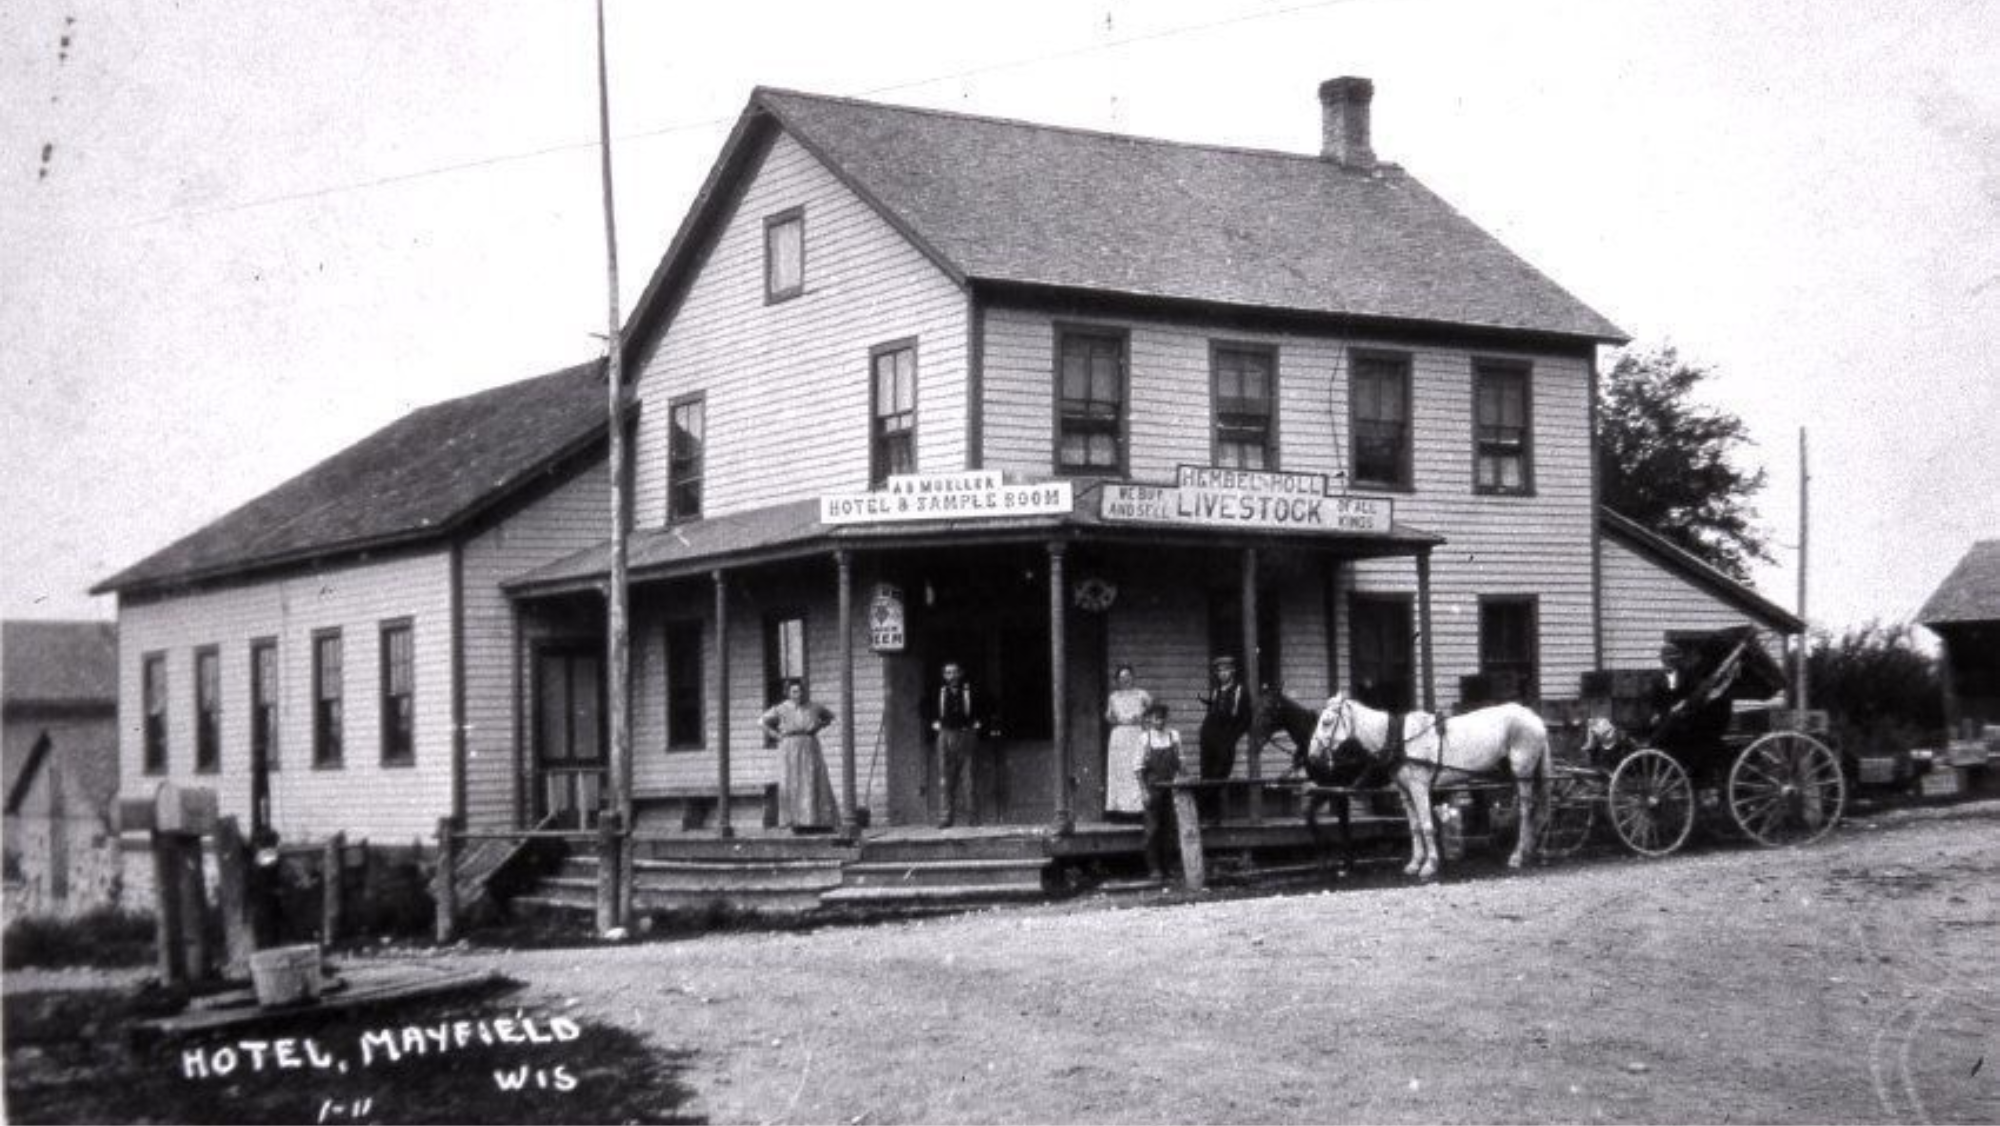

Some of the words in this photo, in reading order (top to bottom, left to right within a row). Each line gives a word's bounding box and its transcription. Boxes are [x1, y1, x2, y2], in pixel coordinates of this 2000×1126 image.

[829, 498, 891, 516] HOTEL
[916, 492, 997, 511] SAMPLE
[1004, 489, 1060, 508] ROOM
[1138, 487, 1163, 502] BUY
[1108, 502, 1134, 517] AND
[1136, 503, 1170, 519] SELL
[1178, 492, 1322, 524] LIVESTOCK
[1355, 500, 1377, 515] ALL
